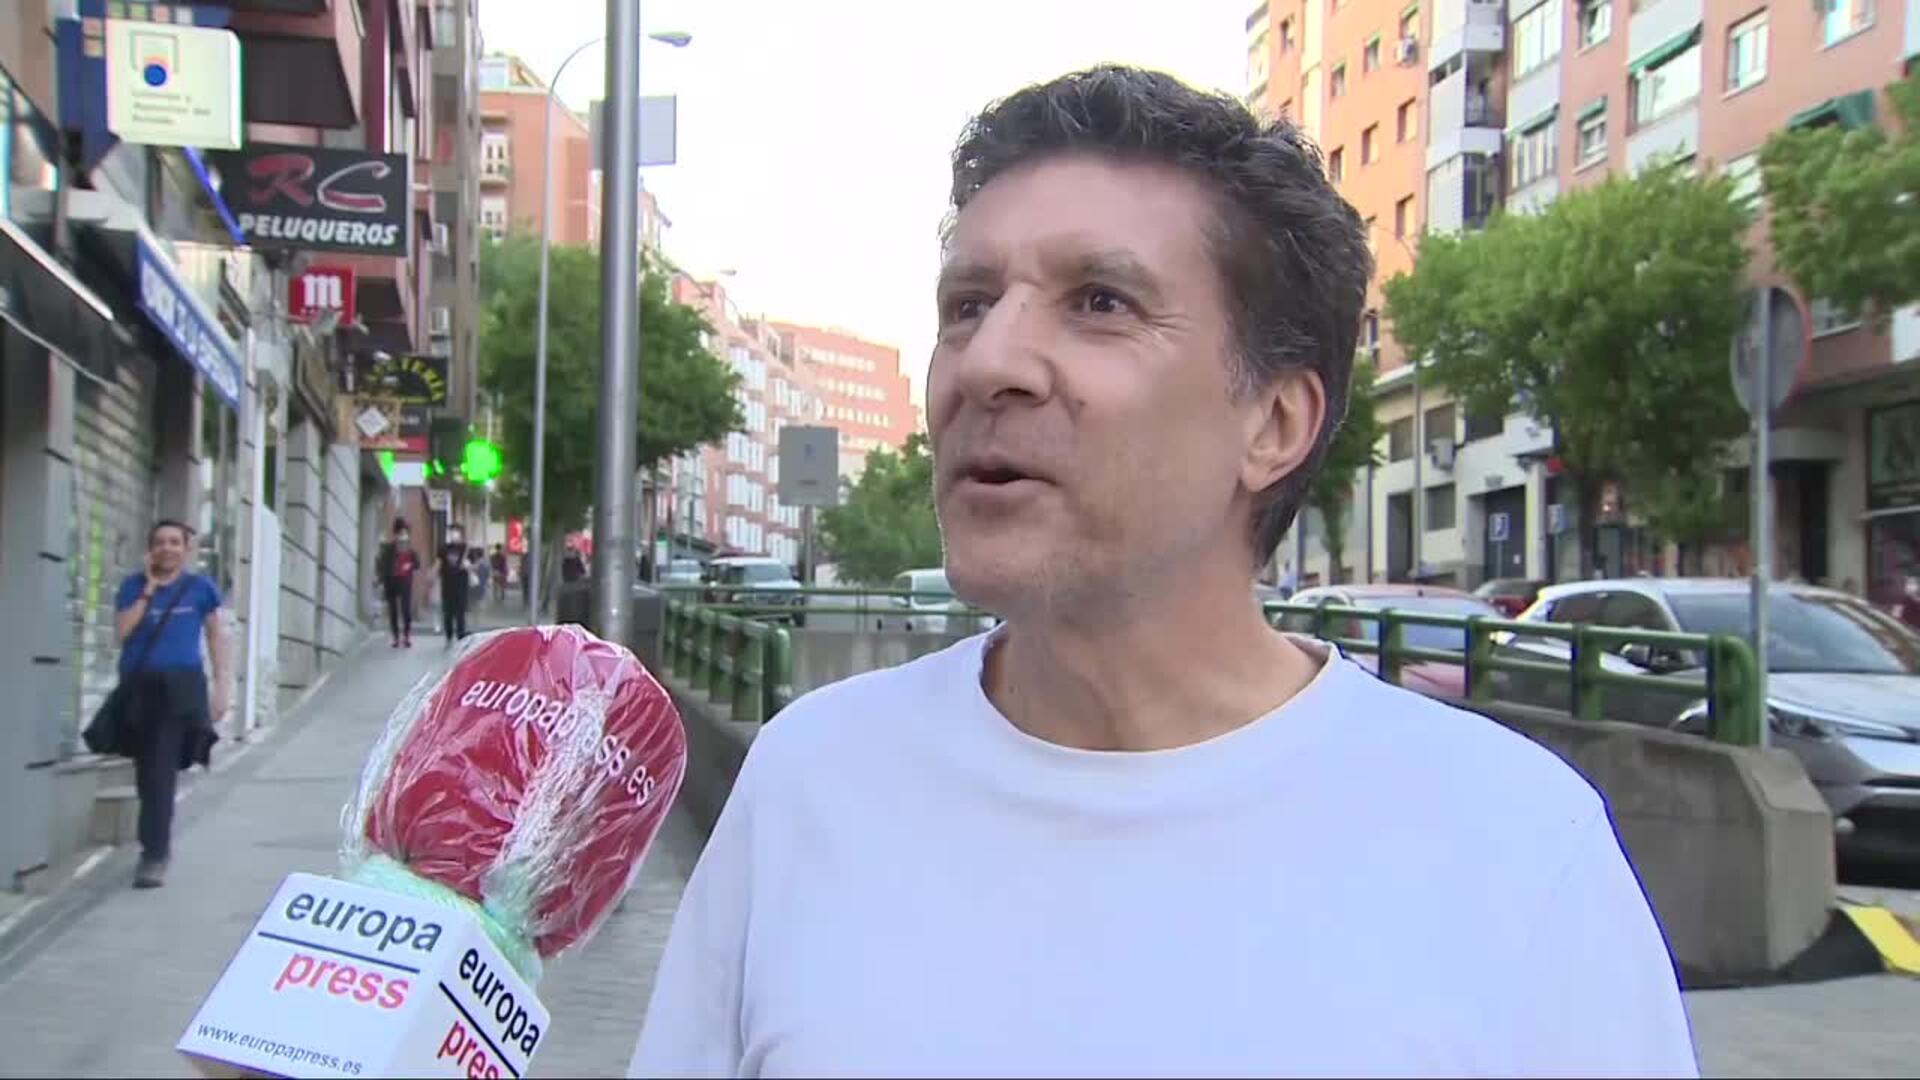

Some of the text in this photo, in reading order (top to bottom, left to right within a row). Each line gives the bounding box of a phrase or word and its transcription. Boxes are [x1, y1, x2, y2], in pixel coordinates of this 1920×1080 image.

[238, 213, 399, 246] PELUQUEROS
[285, 892, 442, 952] europa
[273, 952, 409, 1009] press
[459, 948, 540, 1057] europa
[197, 1023, 363, 1076] www.europapress.es
